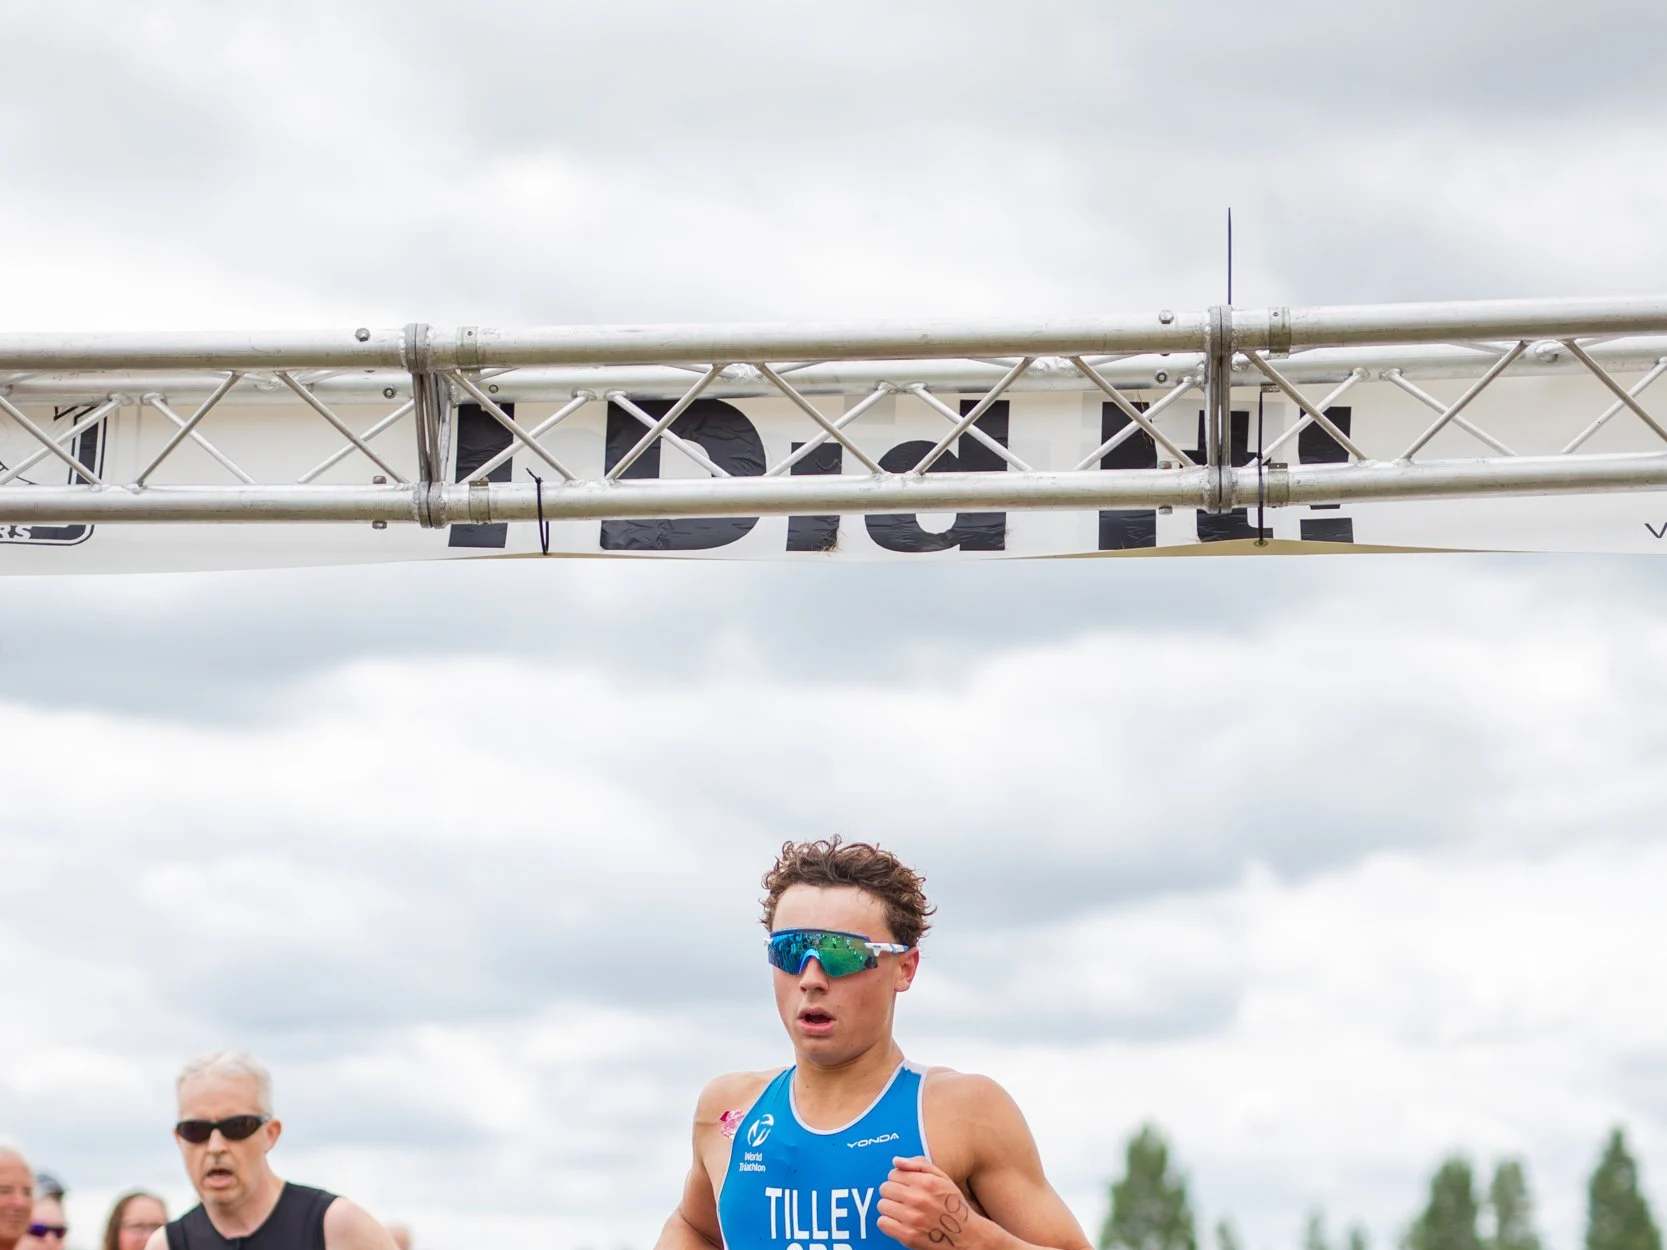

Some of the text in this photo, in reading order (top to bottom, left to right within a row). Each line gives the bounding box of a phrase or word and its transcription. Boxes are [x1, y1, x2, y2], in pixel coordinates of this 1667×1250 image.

[600, 397, 1009, 553] Did
[846, 1132, 900, 1149] YONDA
[744, 1151, 763, 1162] World
[739, 1161, 766, 1173] Triathlon
[765, 1187, 875, 1240] TILLEY
